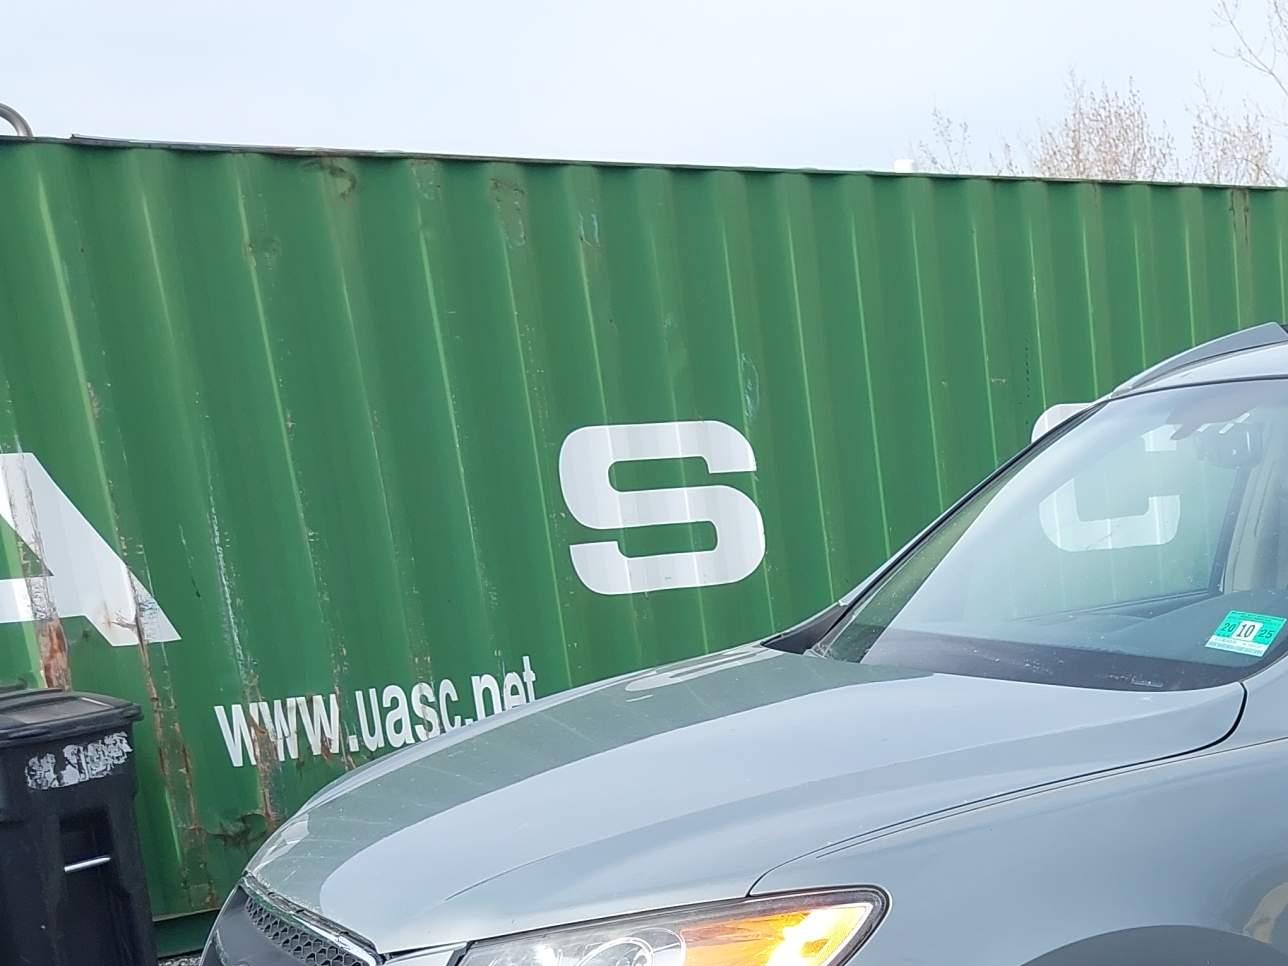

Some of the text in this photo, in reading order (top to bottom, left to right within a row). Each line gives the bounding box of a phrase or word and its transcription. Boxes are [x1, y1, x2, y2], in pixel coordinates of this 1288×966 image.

[1221, 622, 1275, 639] 20 10 25
[214, 656, 537, 767] www.uasc.net
